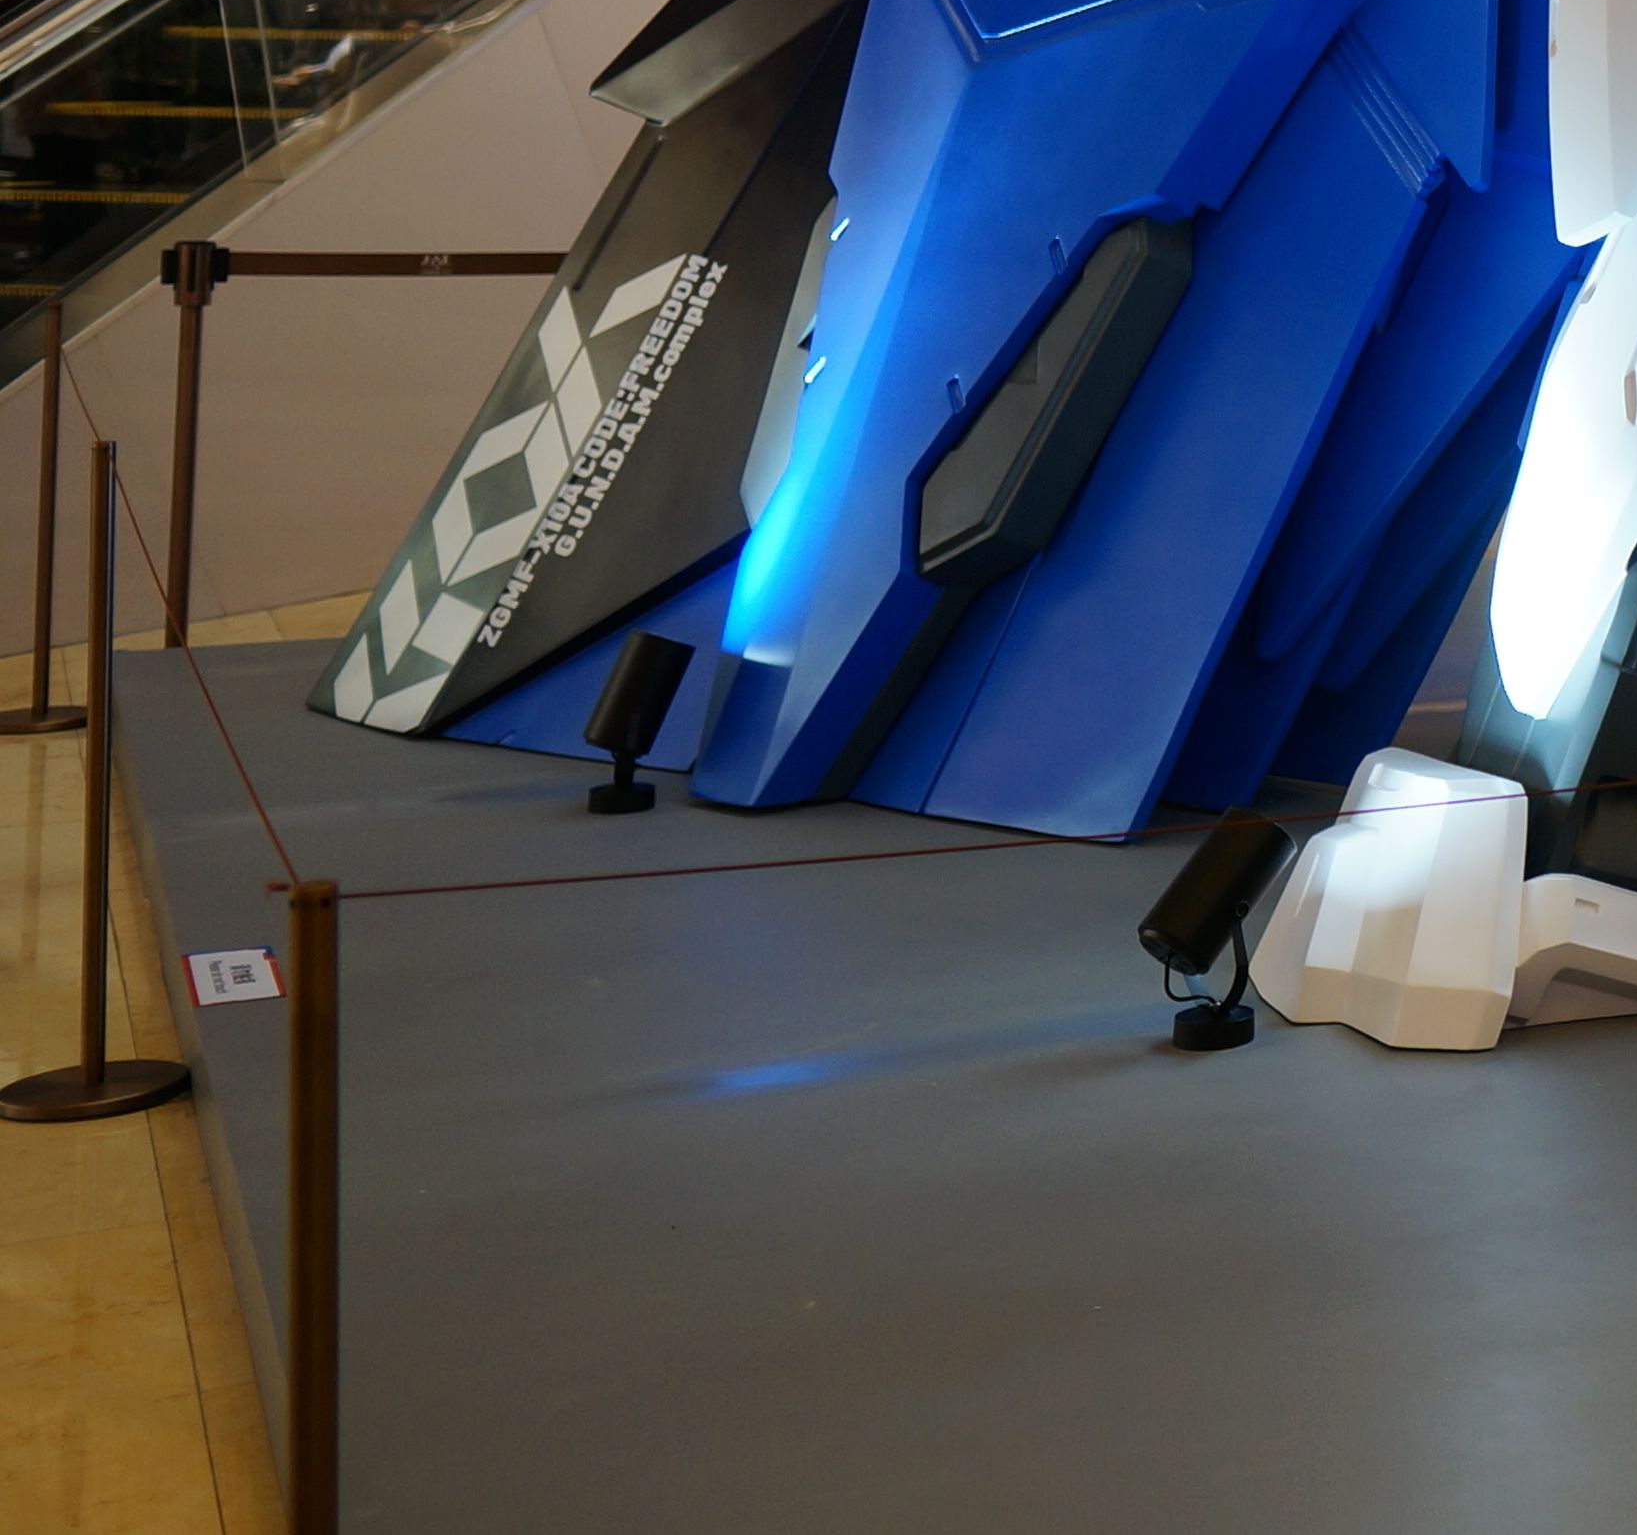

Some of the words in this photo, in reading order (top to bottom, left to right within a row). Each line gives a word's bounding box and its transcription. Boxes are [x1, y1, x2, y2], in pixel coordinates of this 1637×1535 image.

[477, 470, 583, 648] ZGMF-X10A
[572, 254, 708, 480] CODE:FREEDOM
[554, 262, 729, 559] G.U.N.D.A.M.complex
